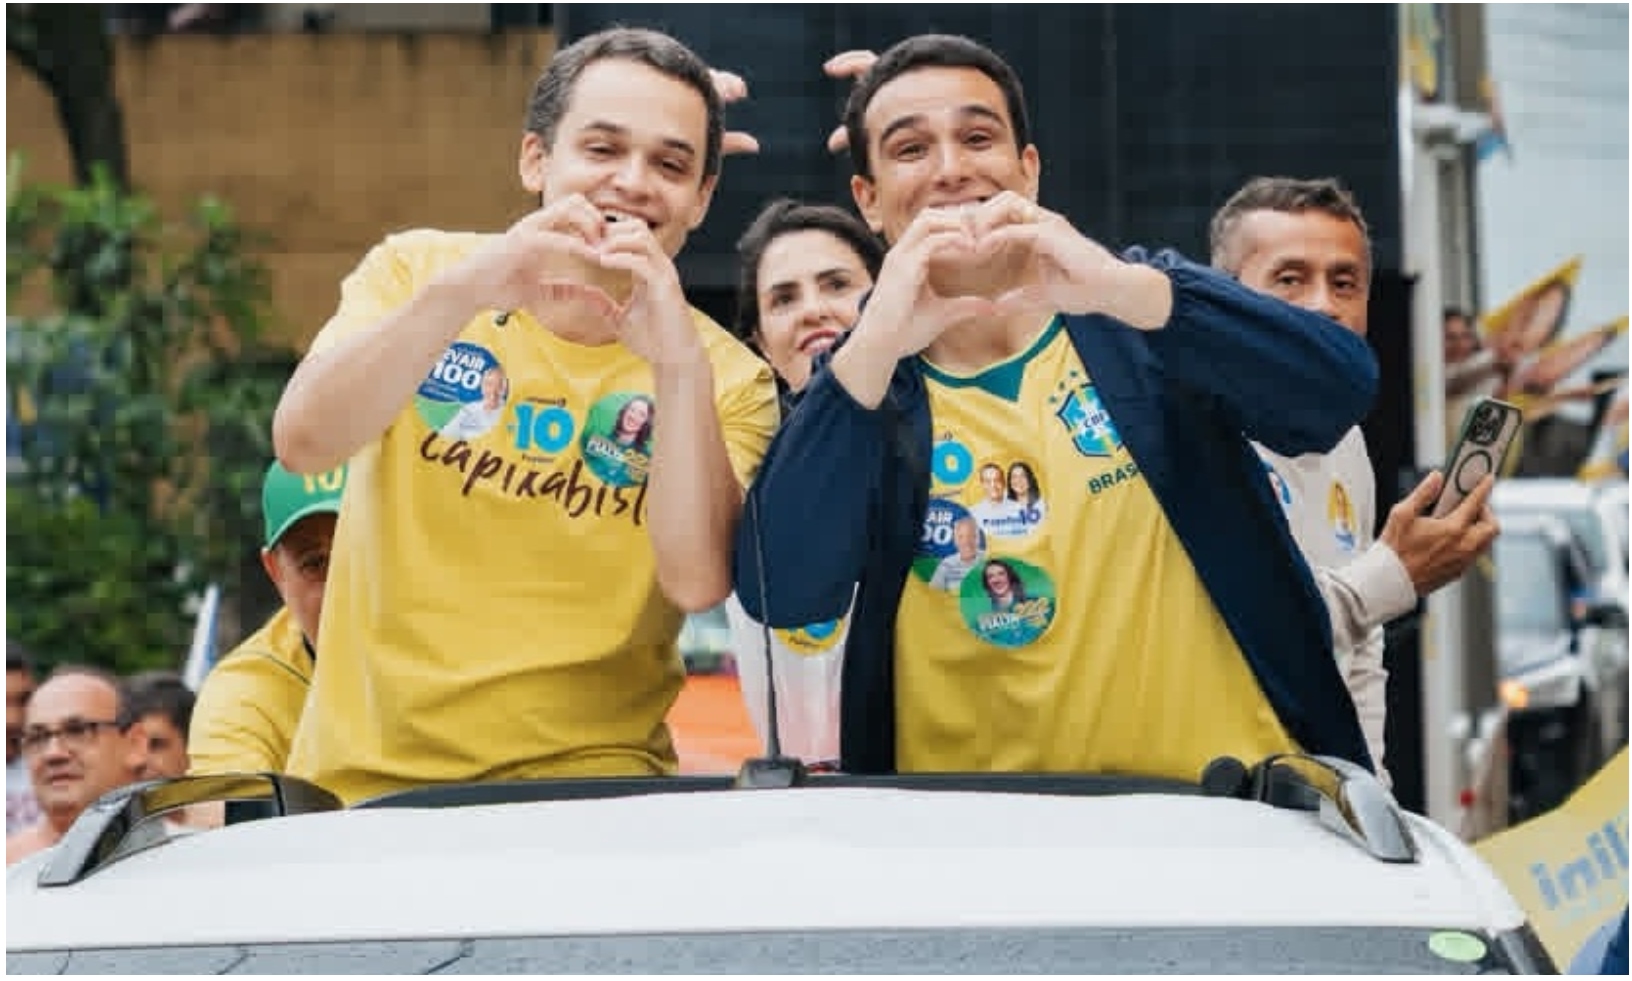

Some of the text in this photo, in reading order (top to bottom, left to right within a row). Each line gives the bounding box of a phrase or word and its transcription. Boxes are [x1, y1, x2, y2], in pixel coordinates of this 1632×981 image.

[433, 361, 482, 390] 100
[515, 402, 575, 454] 10
[420, 430, 649, 527] capixabist
[1088, 463, 1138, 494] BRAS
